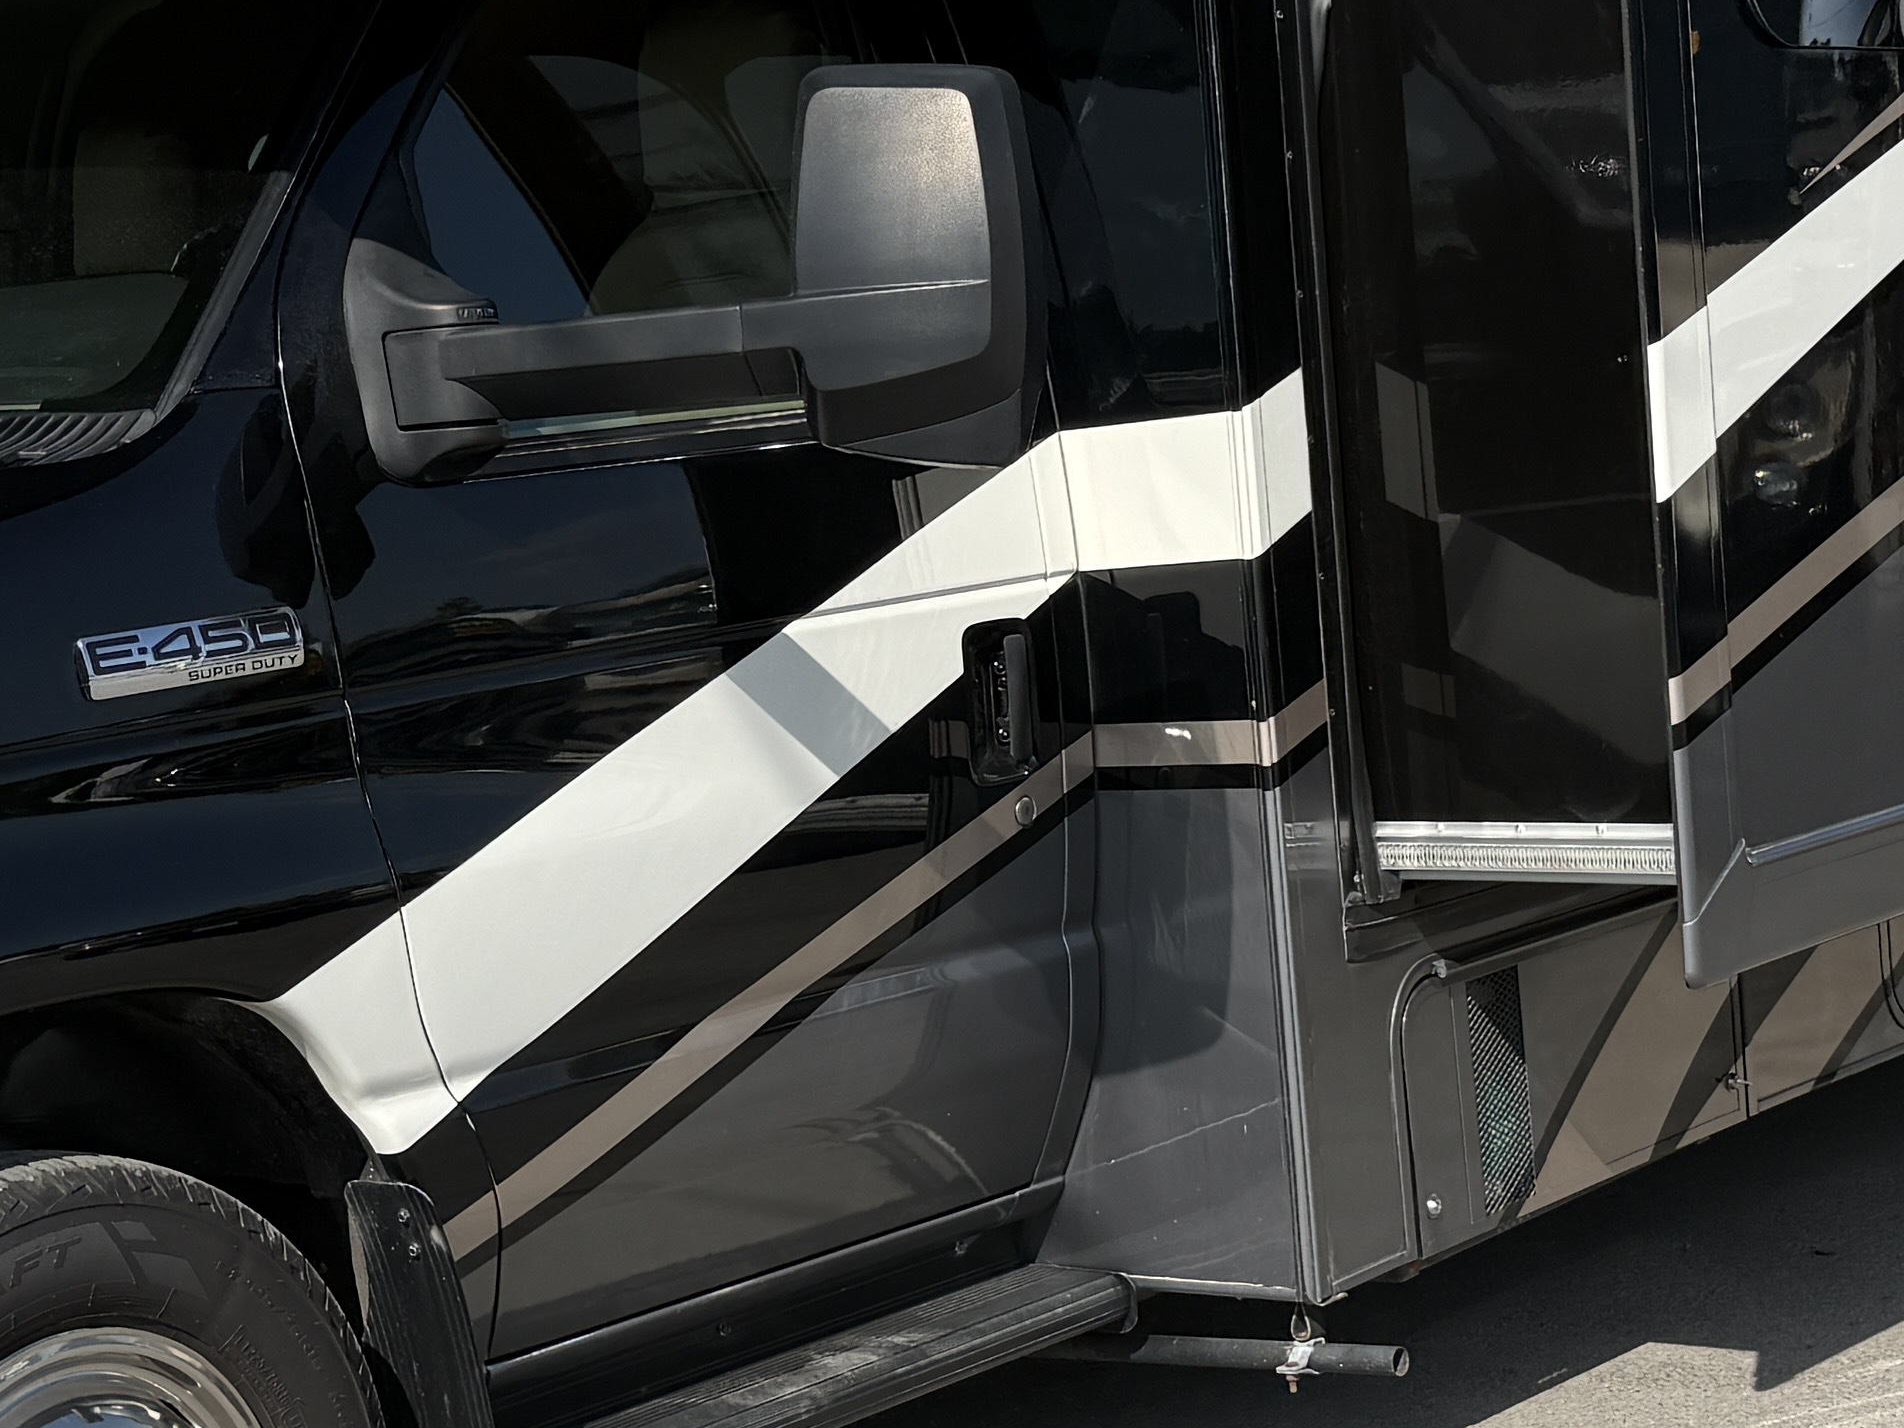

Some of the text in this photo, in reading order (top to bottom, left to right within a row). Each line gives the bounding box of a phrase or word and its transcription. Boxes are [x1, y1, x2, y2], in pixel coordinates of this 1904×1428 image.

[86, 613, 300, 676] E-450
[188, 653, 298, 682] SUPER DUTY
